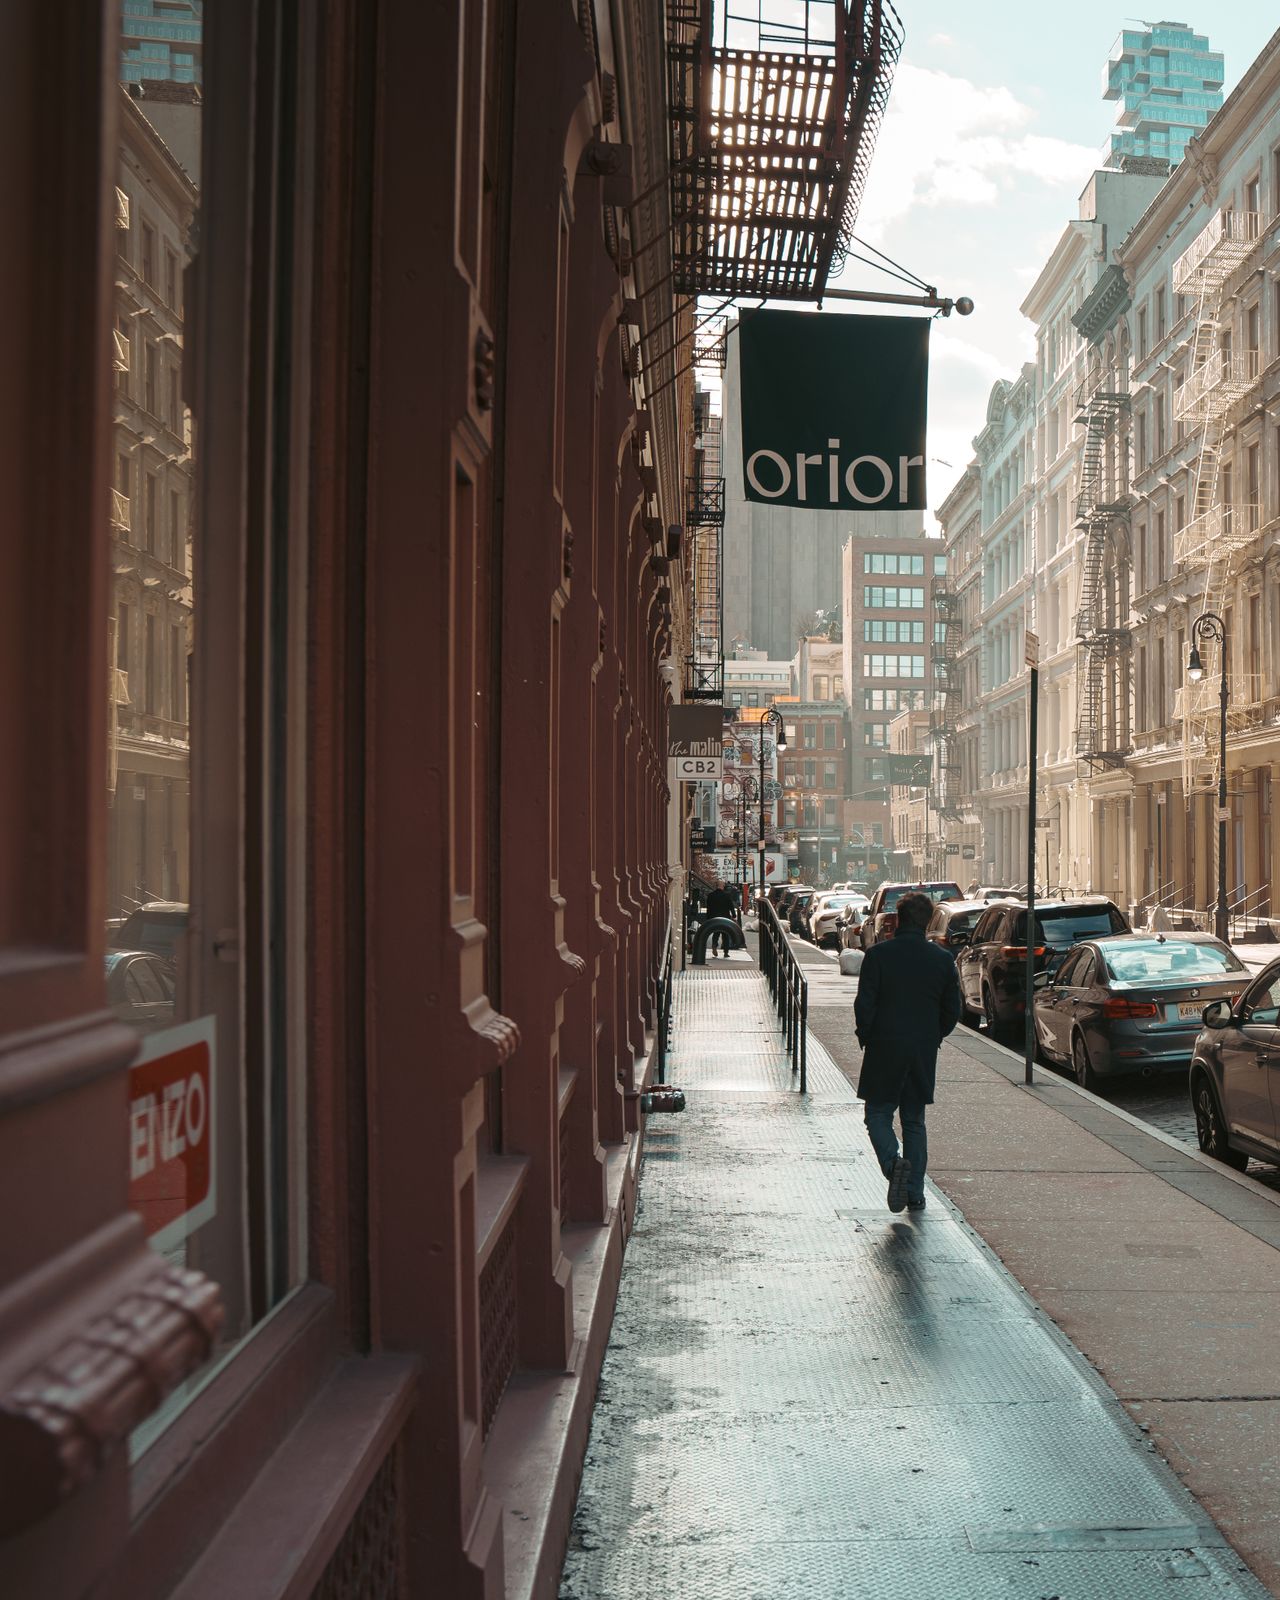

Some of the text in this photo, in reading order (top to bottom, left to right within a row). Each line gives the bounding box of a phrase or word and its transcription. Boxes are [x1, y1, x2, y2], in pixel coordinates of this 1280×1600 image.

[746, 438, 924, 504] orior
[669, 737, 722, 756] the malin
[682, 761, 716, 773] CB2
